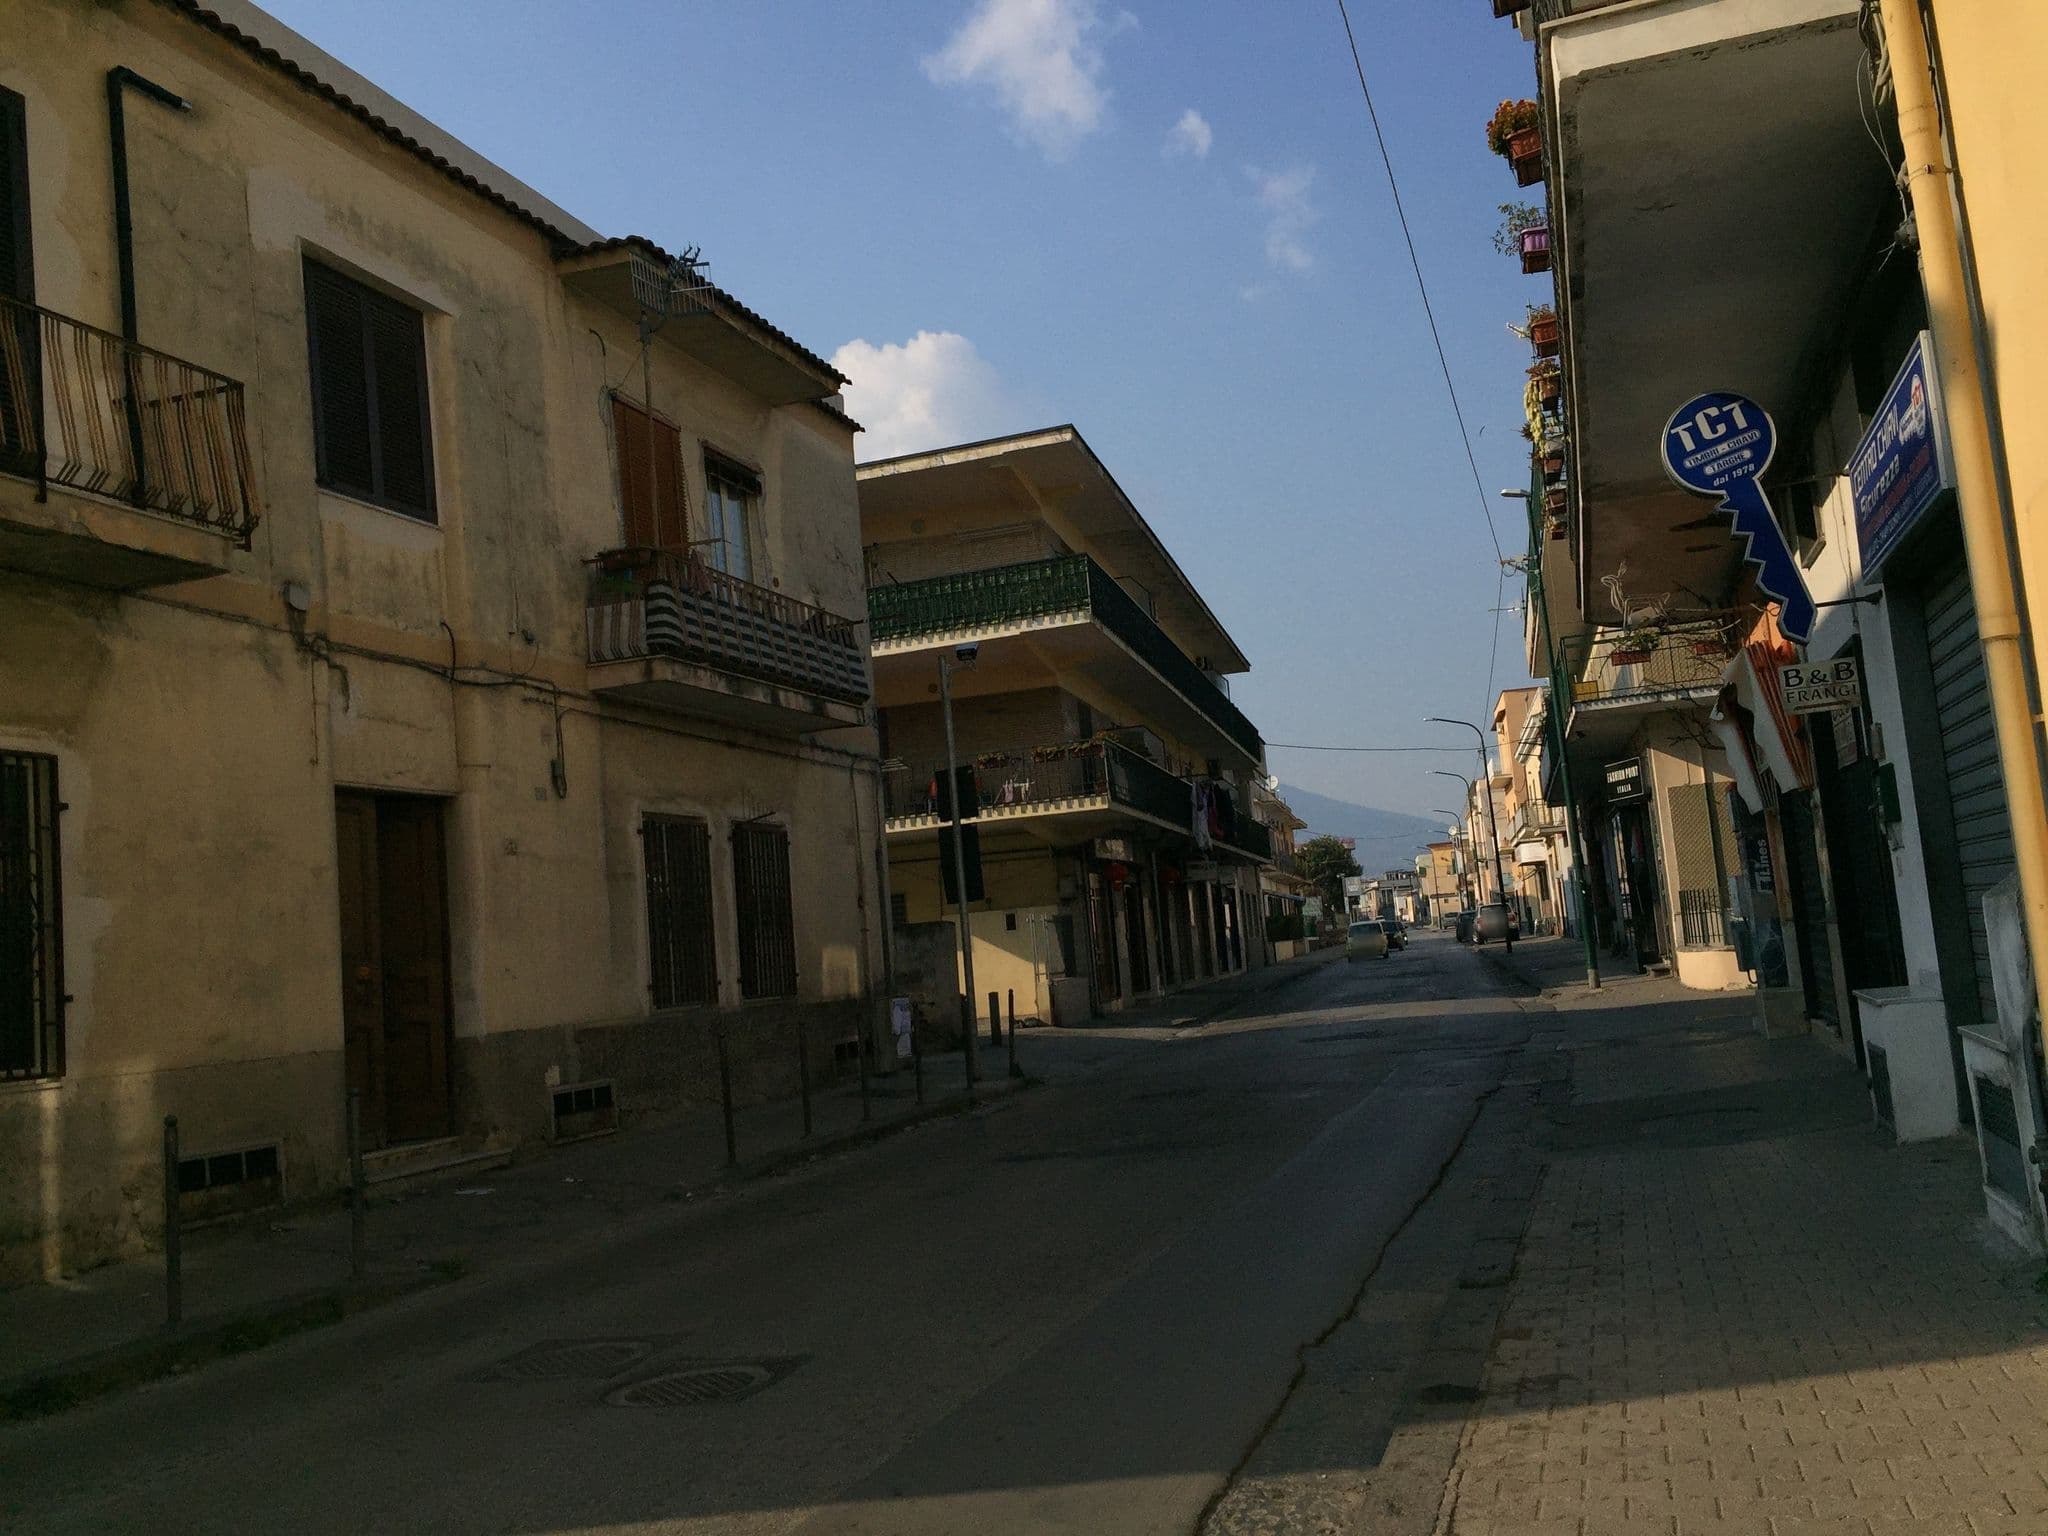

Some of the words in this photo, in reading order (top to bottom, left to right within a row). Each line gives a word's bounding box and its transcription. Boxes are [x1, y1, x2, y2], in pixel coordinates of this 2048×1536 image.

[1670, 400, 1748, 452] TCT
[1688, 447, 1720, 466] TIMBRI
[1727, 431, 1758, 449] CHIAVI
[1709, 452, 1746, 473] TARGHE
[1713, 473, 1729, 487] dal
[1731, 463, 1755, 479] 1978
[1854, 440, 1878, 498] CENTRO
[1783, 668, 1804, 688] B
[1810, 669, 1830, 685] &
[1834, 662, 1855, 681] B
[1786, 684, 1857, 703] FRANGI
